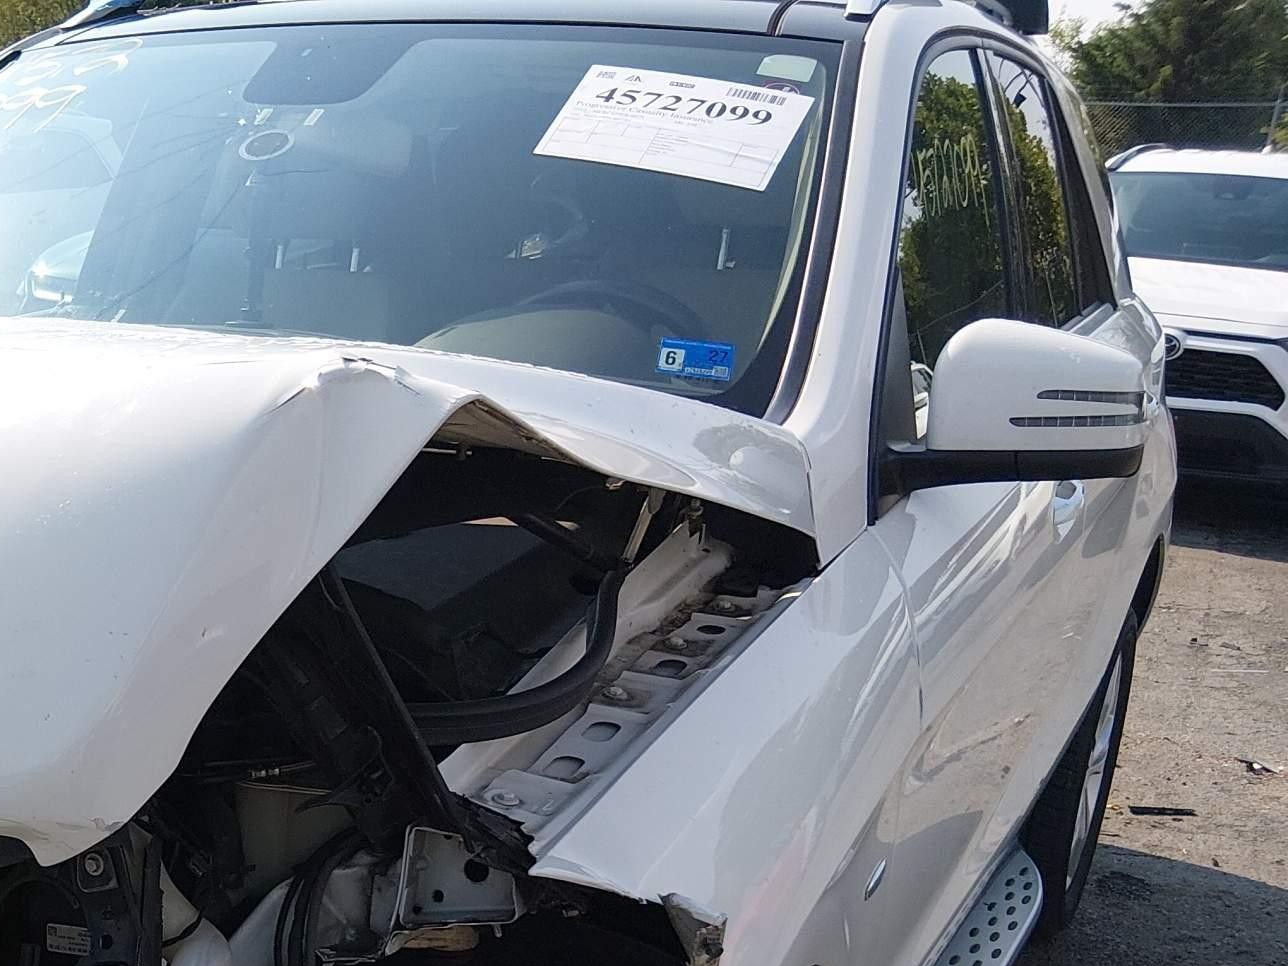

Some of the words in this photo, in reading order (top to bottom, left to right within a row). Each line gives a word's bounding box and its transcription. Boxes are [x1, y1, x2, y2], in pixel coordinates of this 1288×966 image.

[595, 87, 773, 126] 45727099
[665, 350, 677, 366] 6
[710, 350, 729, 362] 27
